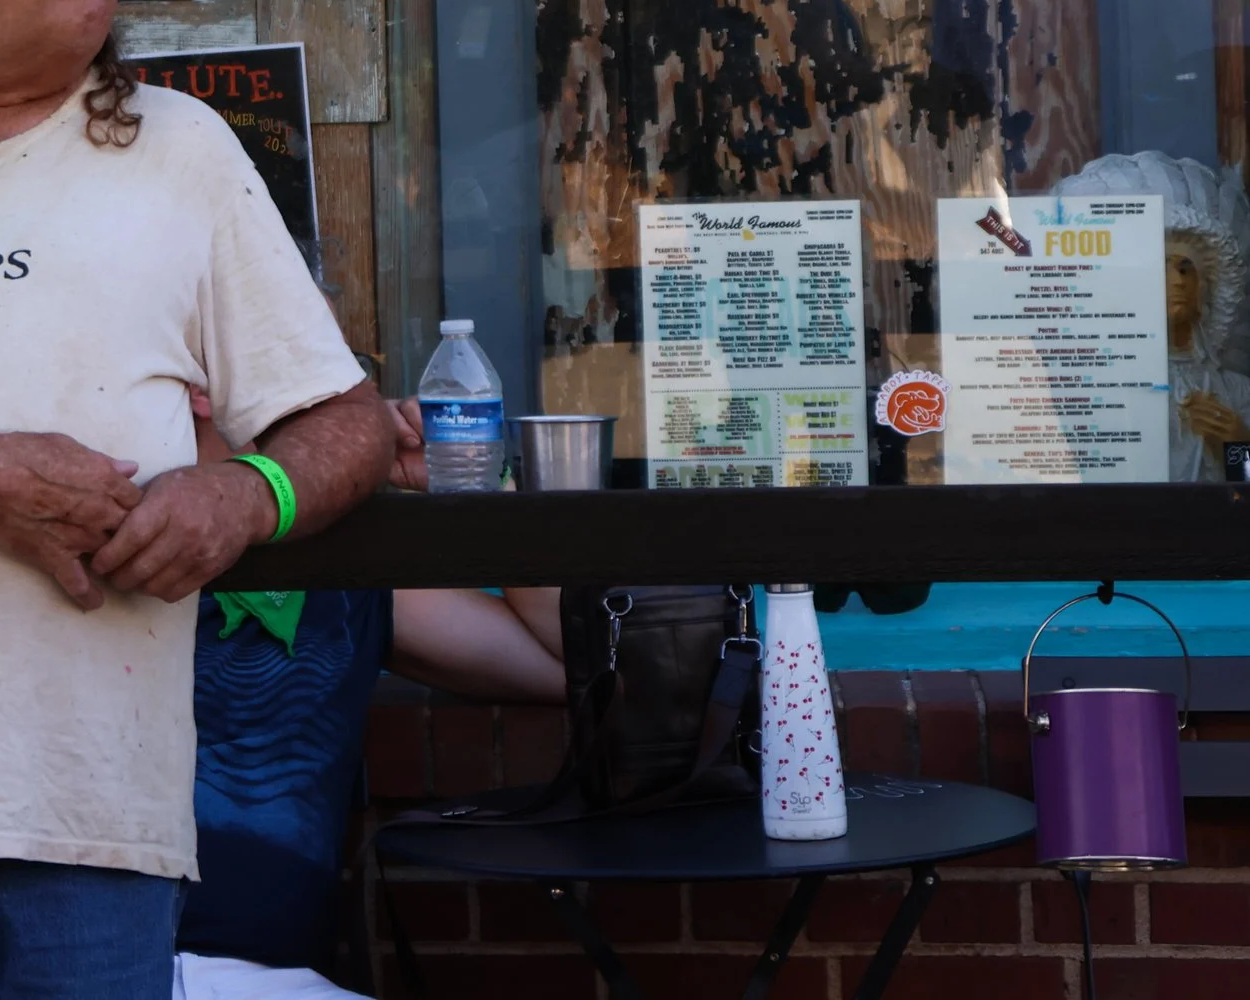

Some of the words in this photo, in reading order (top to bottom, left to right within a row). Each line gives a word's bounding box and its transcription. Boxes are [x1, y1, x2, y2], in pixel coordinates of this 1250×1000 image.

[699, 216, 745, 230] World
[747, 215, 802, 230] Famous
[984, 215, 1004, 234] THIS
[1045, 230, 1112, 257] FOOD
